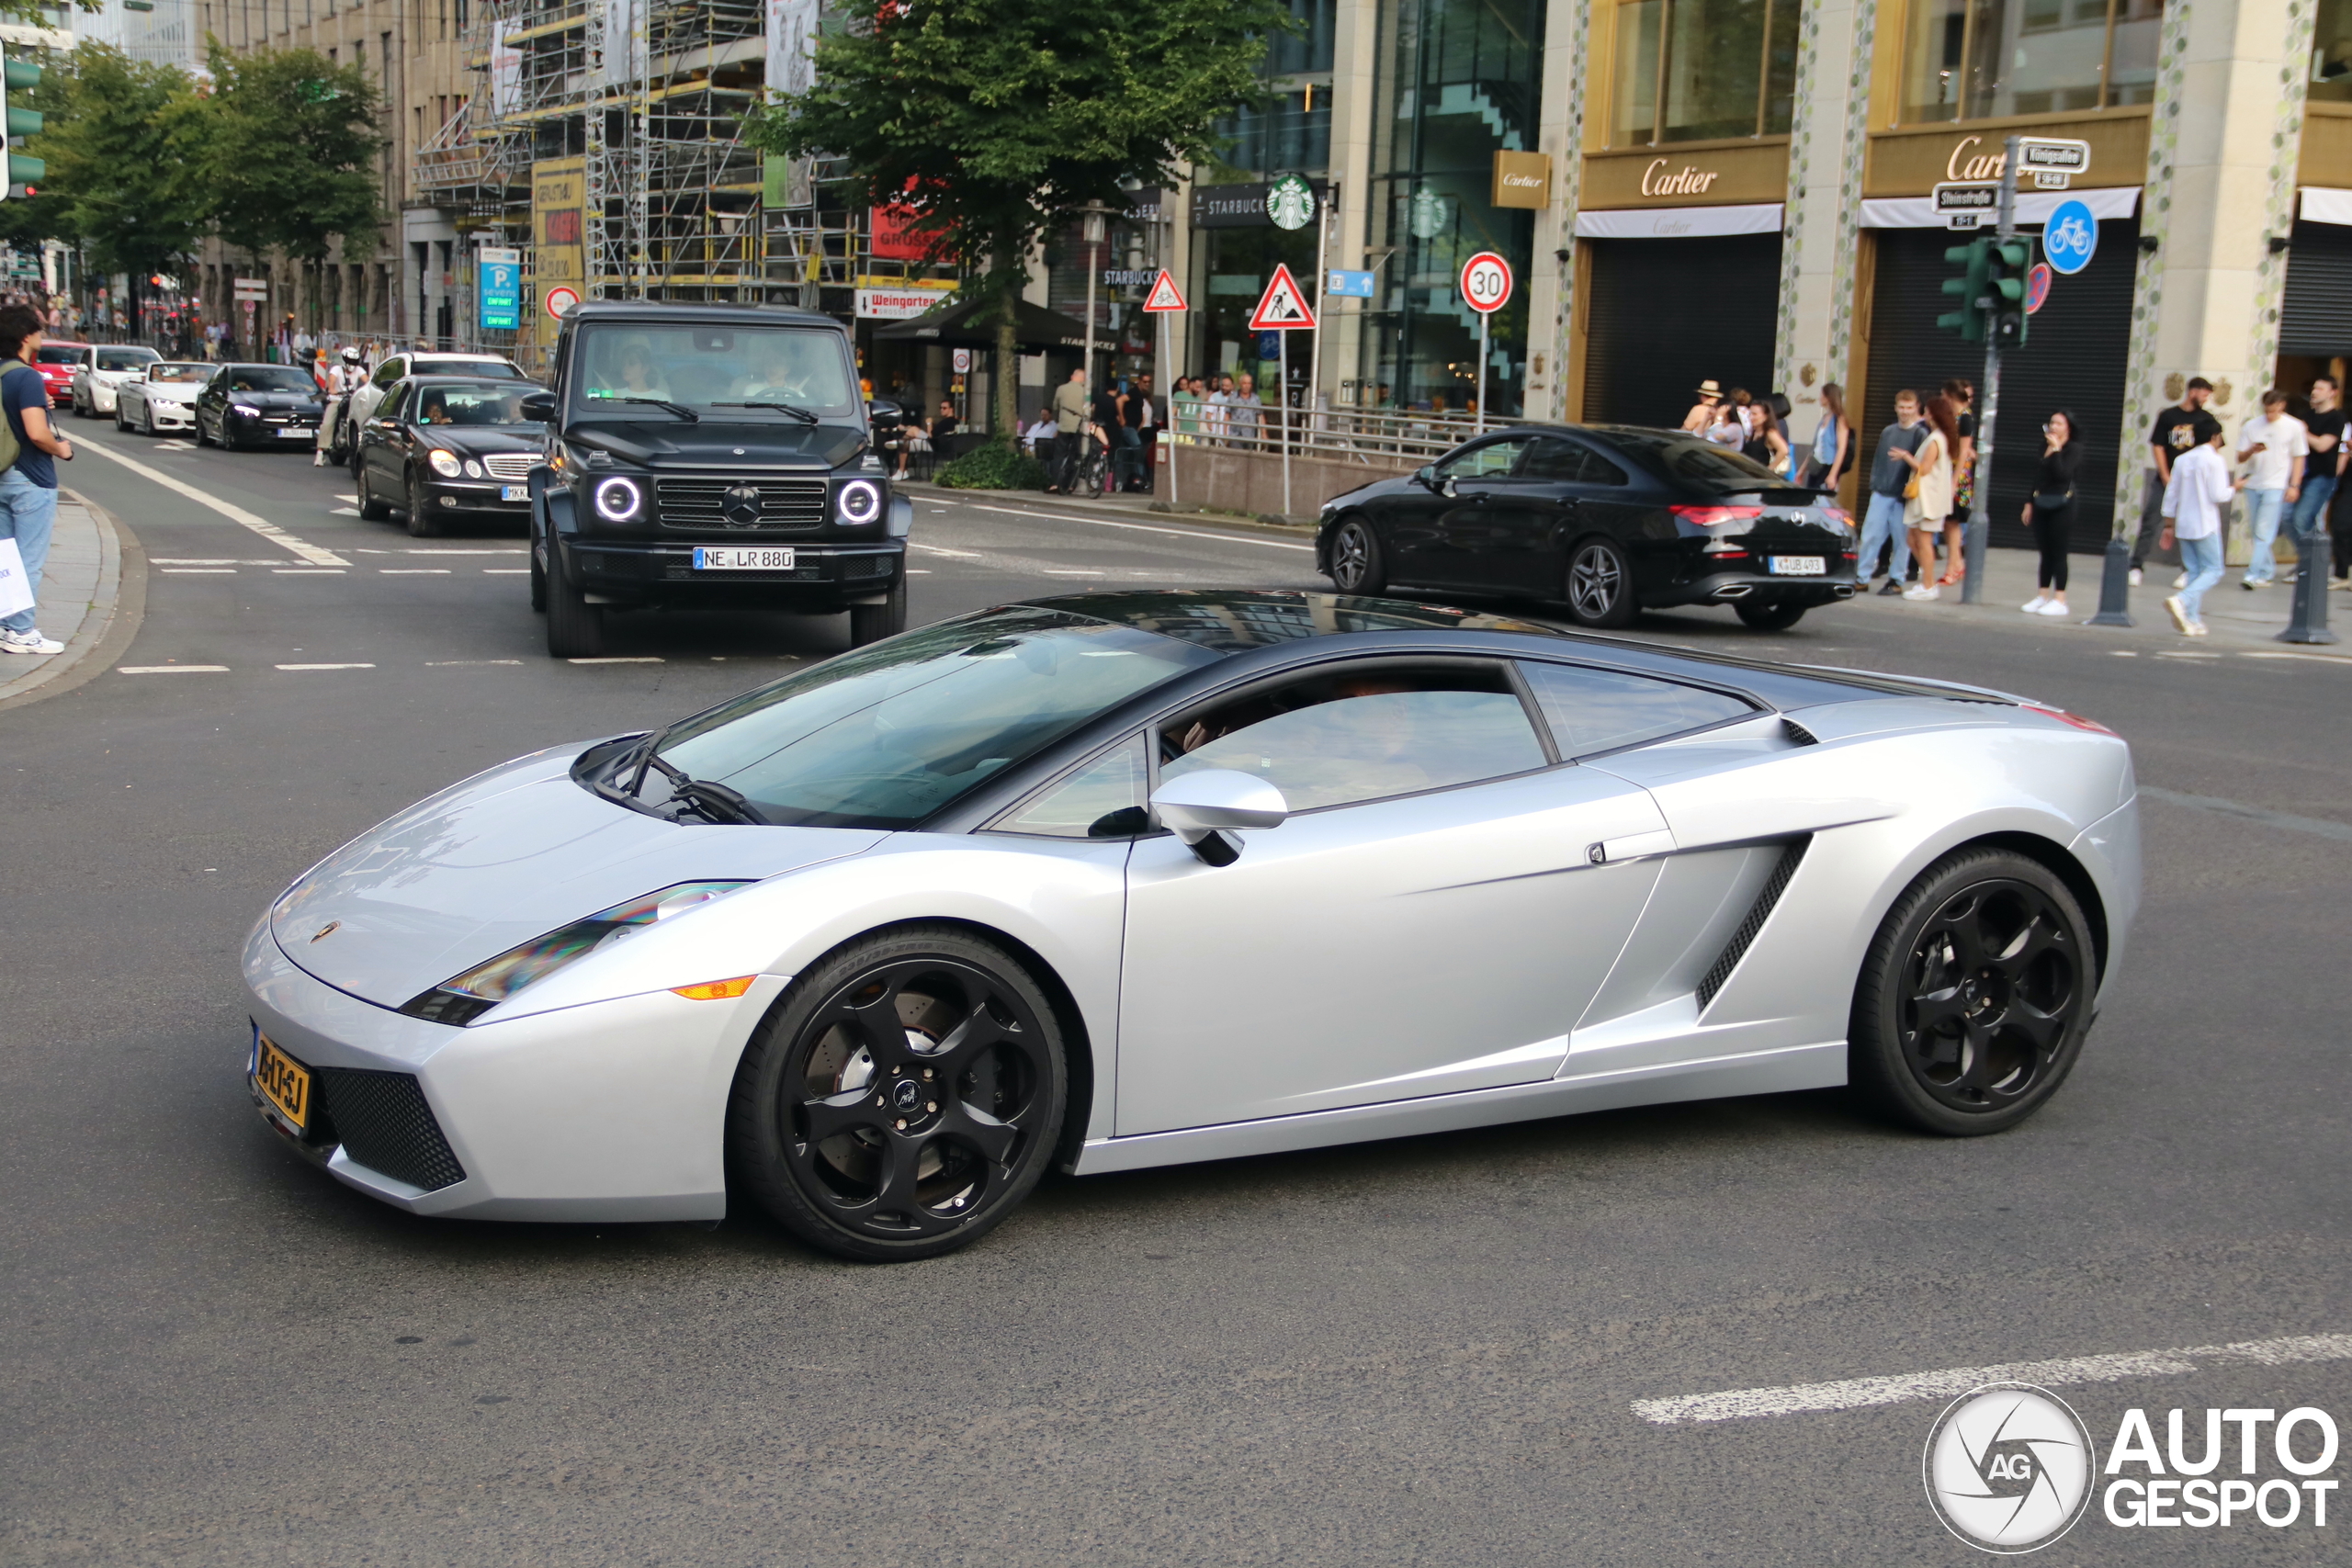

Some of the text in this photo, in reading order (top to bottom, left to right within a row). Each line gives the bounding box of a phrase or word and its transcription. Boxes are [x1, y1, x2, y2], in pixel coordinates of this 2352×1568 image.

[2029, 148, 2080, 164] Königsallee
[1503, 173, 1544, 187] Cartier
[1642, 158, 1718, 197] Cartier
[1941, 190, 1991, 206] Steinstraße
[1209, 200, 1265, 215] STARBUCK
[1653, 215, 1692, 234] Cartier
[1473, 271, 1500, 297] 30
[483, 288, 517, 298] sevens
[872, 295, 936, 309] Weingarten
[705, 551, 791, 567] NE LR 880
